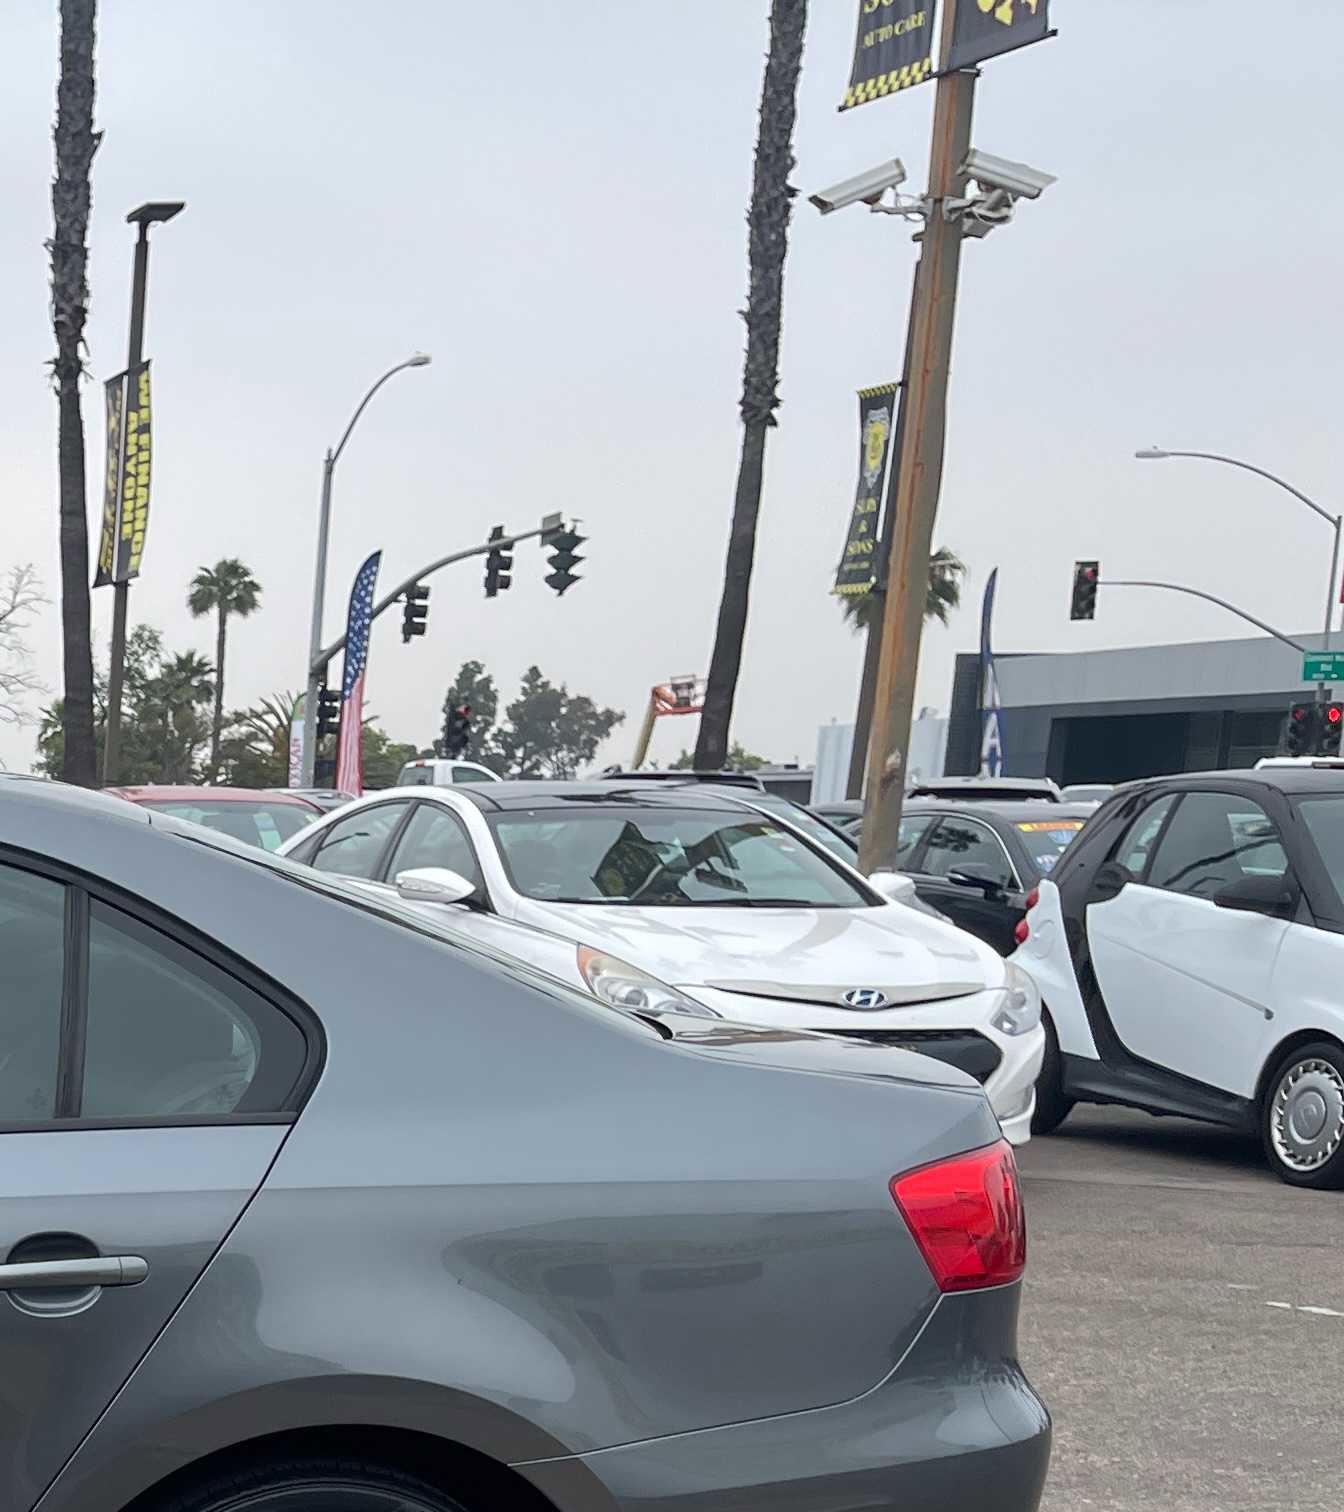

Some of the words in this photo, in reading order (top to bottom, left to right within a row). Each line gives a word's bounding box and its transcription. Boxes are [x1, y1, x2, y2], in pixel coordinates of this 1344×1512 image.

[894, 11, 927, 35] CARE
[138, 369, 151, 425] WE
[122, 411, 139, 540] ANYONE
[129, 432, 151, 571] FINANCE
